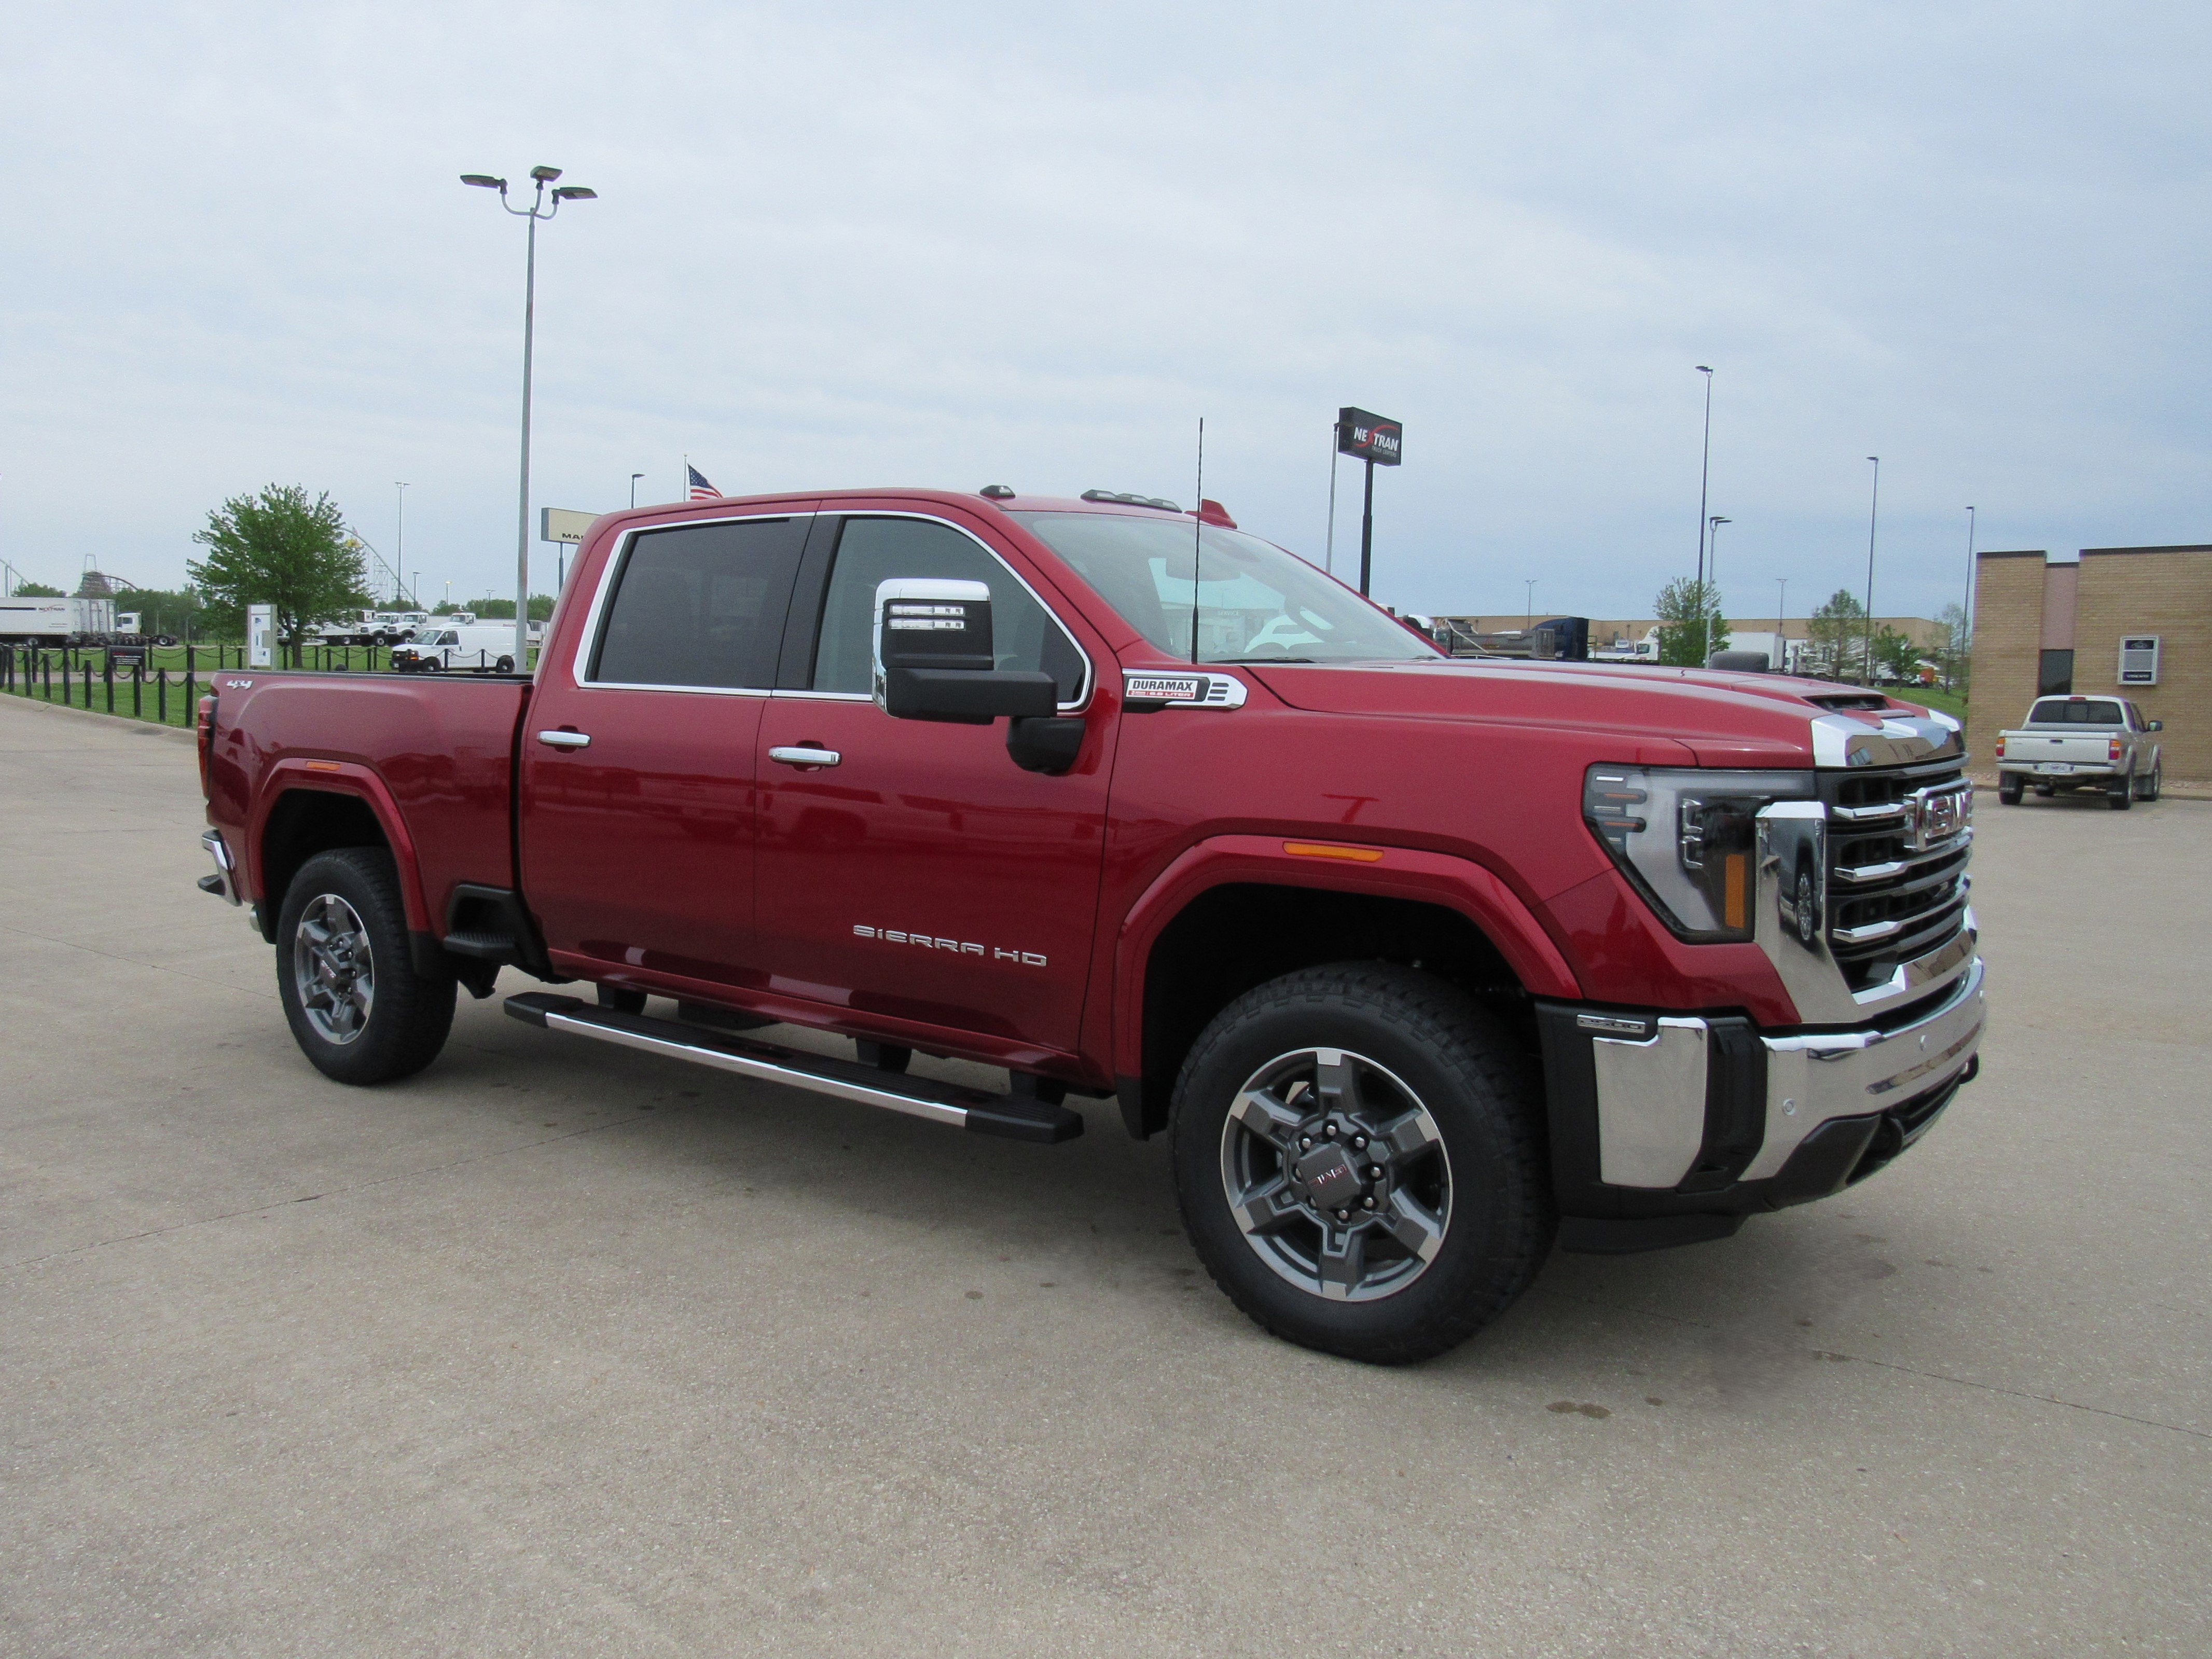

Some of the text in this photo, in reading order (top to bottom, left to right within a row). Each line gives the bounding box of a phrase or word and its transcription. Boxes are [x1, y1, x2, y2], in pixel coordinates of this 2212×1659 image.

[1353, 426, 1399, 452] NEXTRAN
[1132, 680, 1193, 691] DURAMAX
[853, 925, 1047, 966] SIERRA HD
[1580, 1017, 1641, 1030] 2500
[1308, 1164, 1348, 1189] GMC
